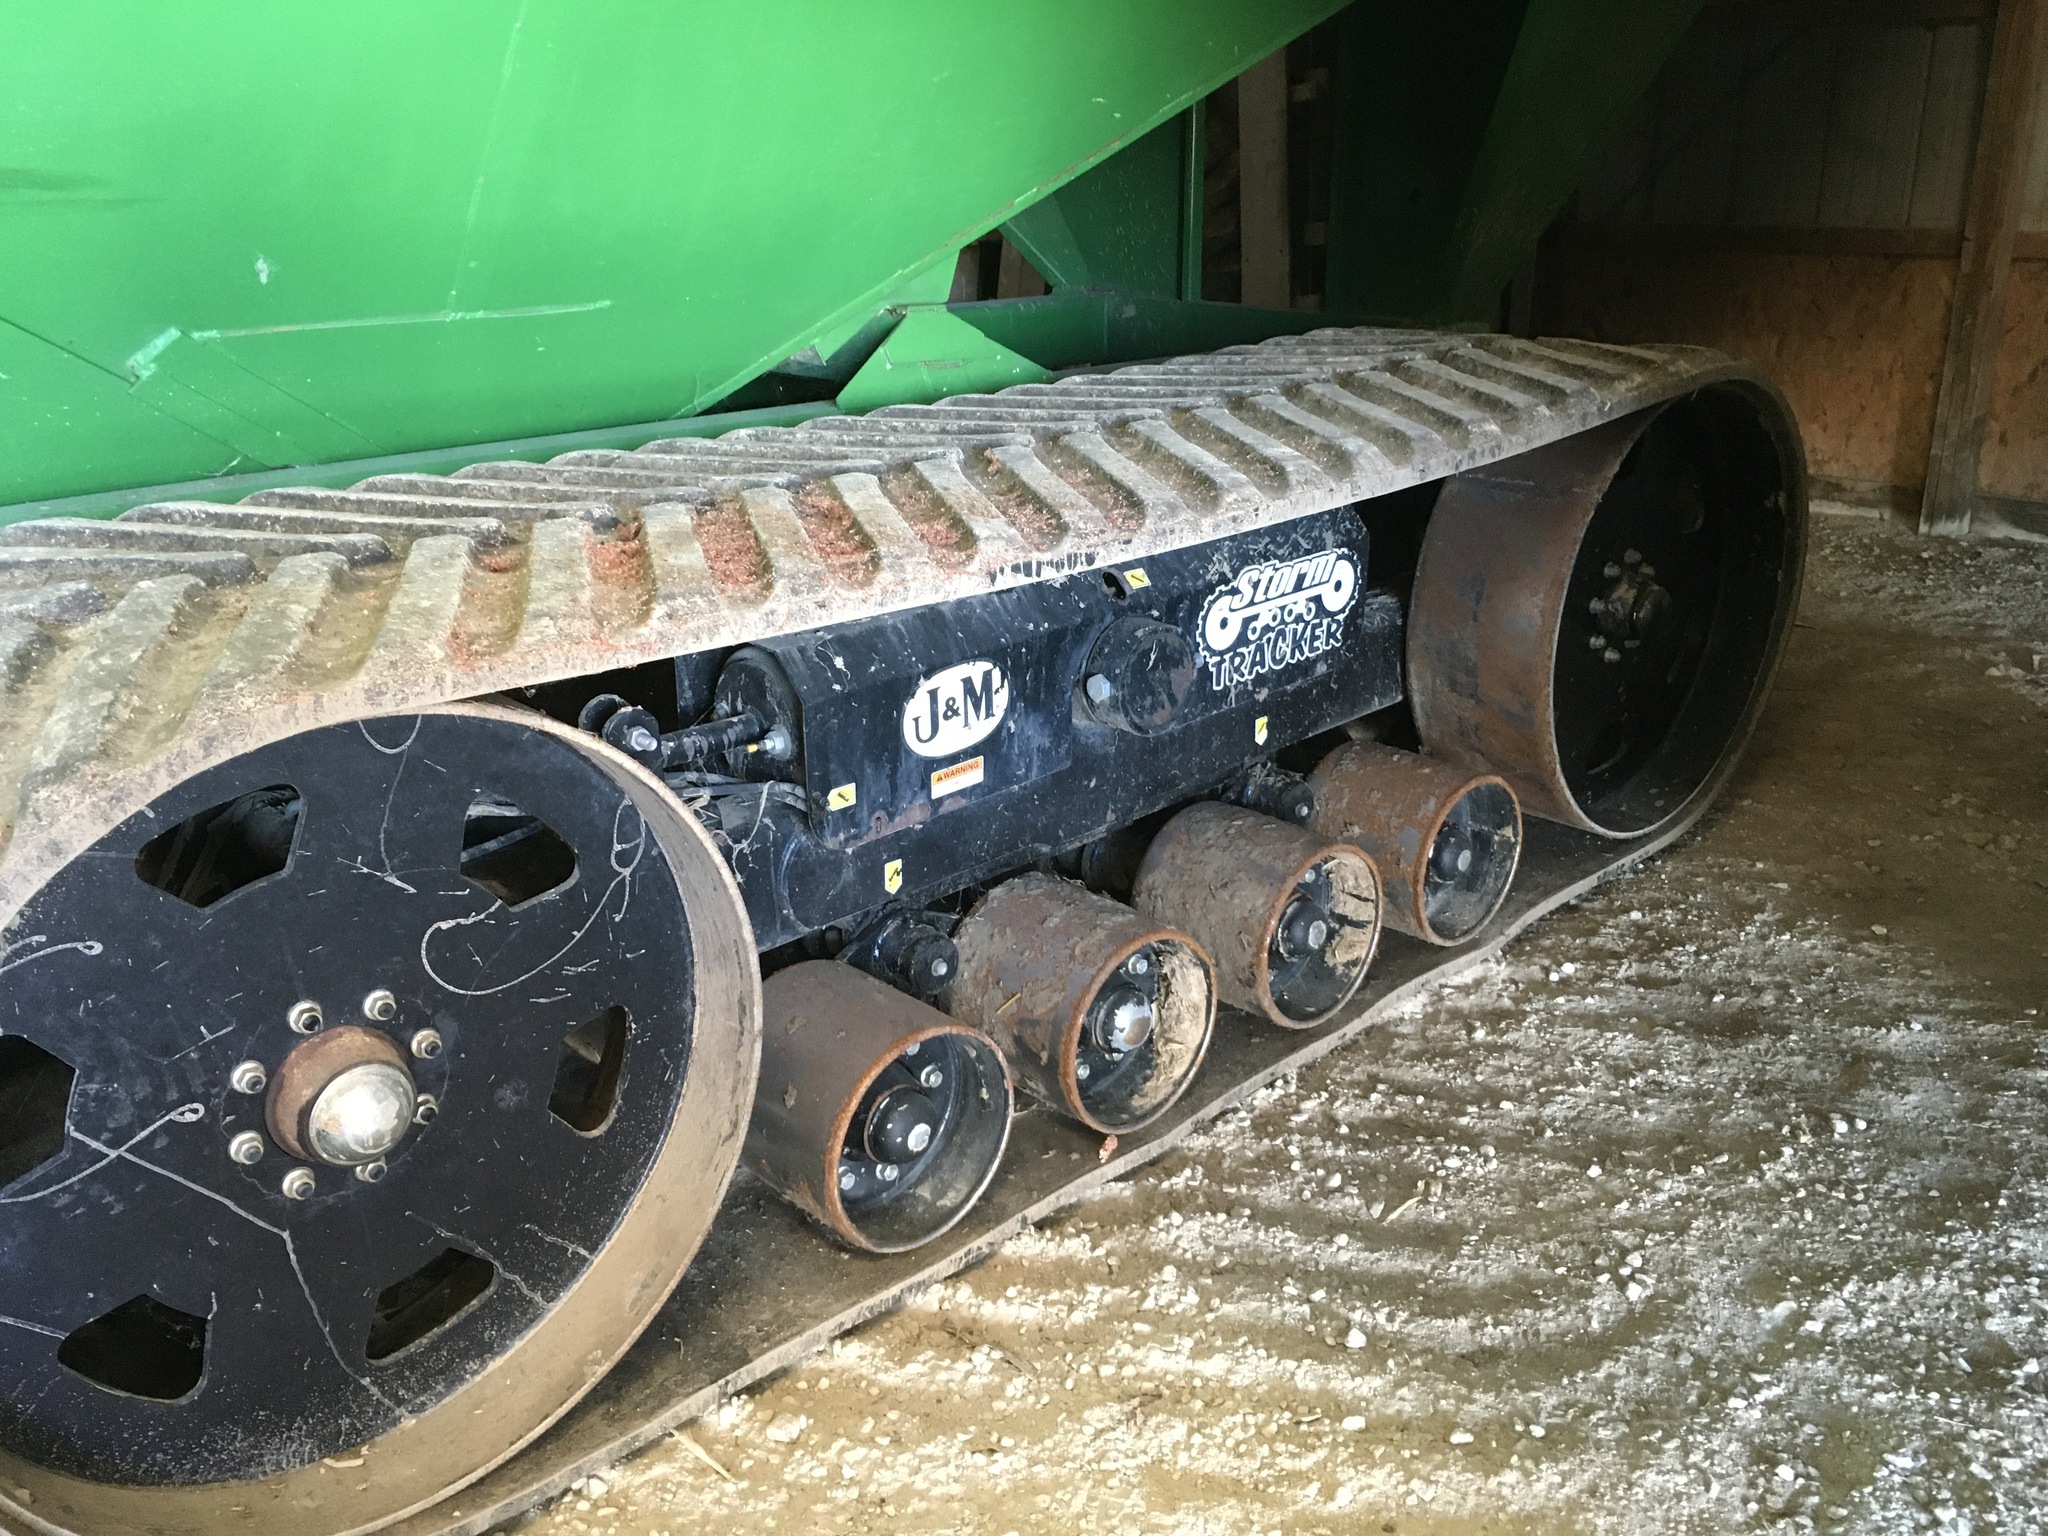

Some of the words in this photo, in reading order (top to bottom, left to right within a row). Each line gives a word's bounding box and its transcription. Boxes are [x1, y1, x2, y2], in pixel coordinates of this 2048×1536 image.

[1230, 552, 1337, 610] Storm
[1209, 617, 1342, 690] TRACKER
[912, 667, 996, 743] J&M
[943, 761, 979, 780] WARNING
